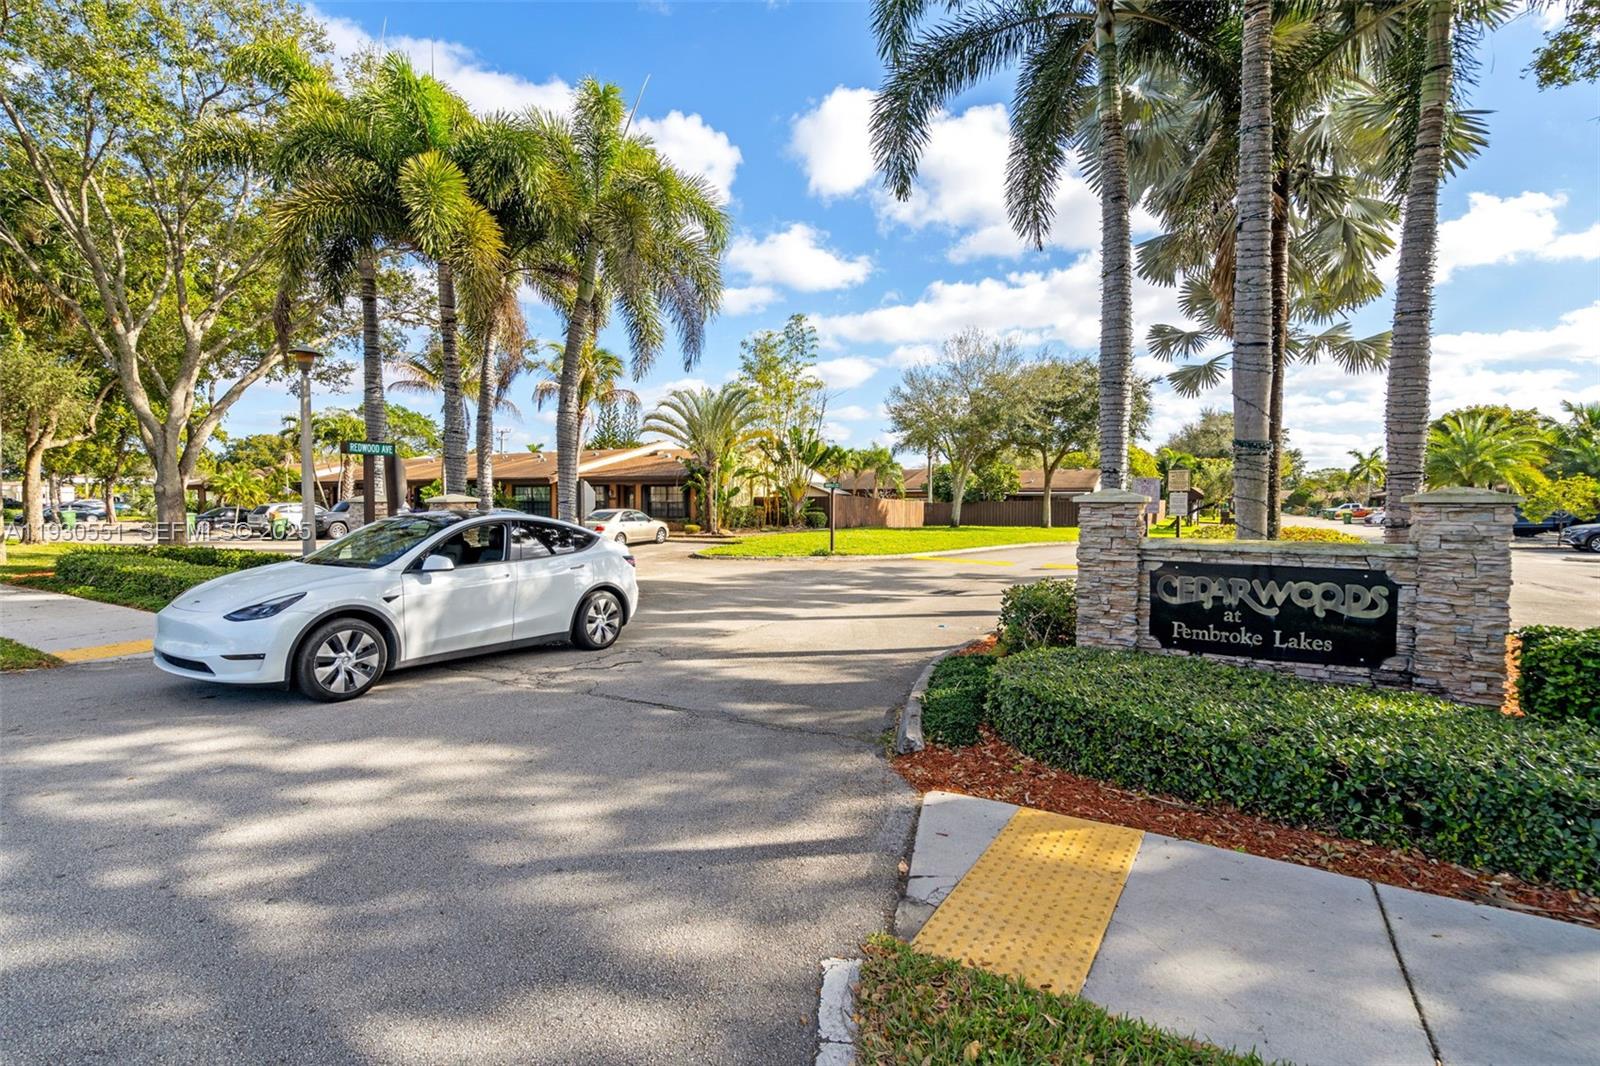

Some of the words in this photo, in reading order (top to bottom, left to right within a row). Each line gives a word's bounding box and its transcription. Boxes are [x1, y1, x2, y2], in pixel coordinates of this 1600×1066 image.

[349, 443, 380, 453] REDWOOD
[381, 445, 393, 454] AVE
[1156, 574, 1390, 620] CEDARWOODS
[1223, 608, 1242, 623] at
[1171, 621, 1263, 646] Pembroke
[1273, 630, 1333, 651] Lakes
